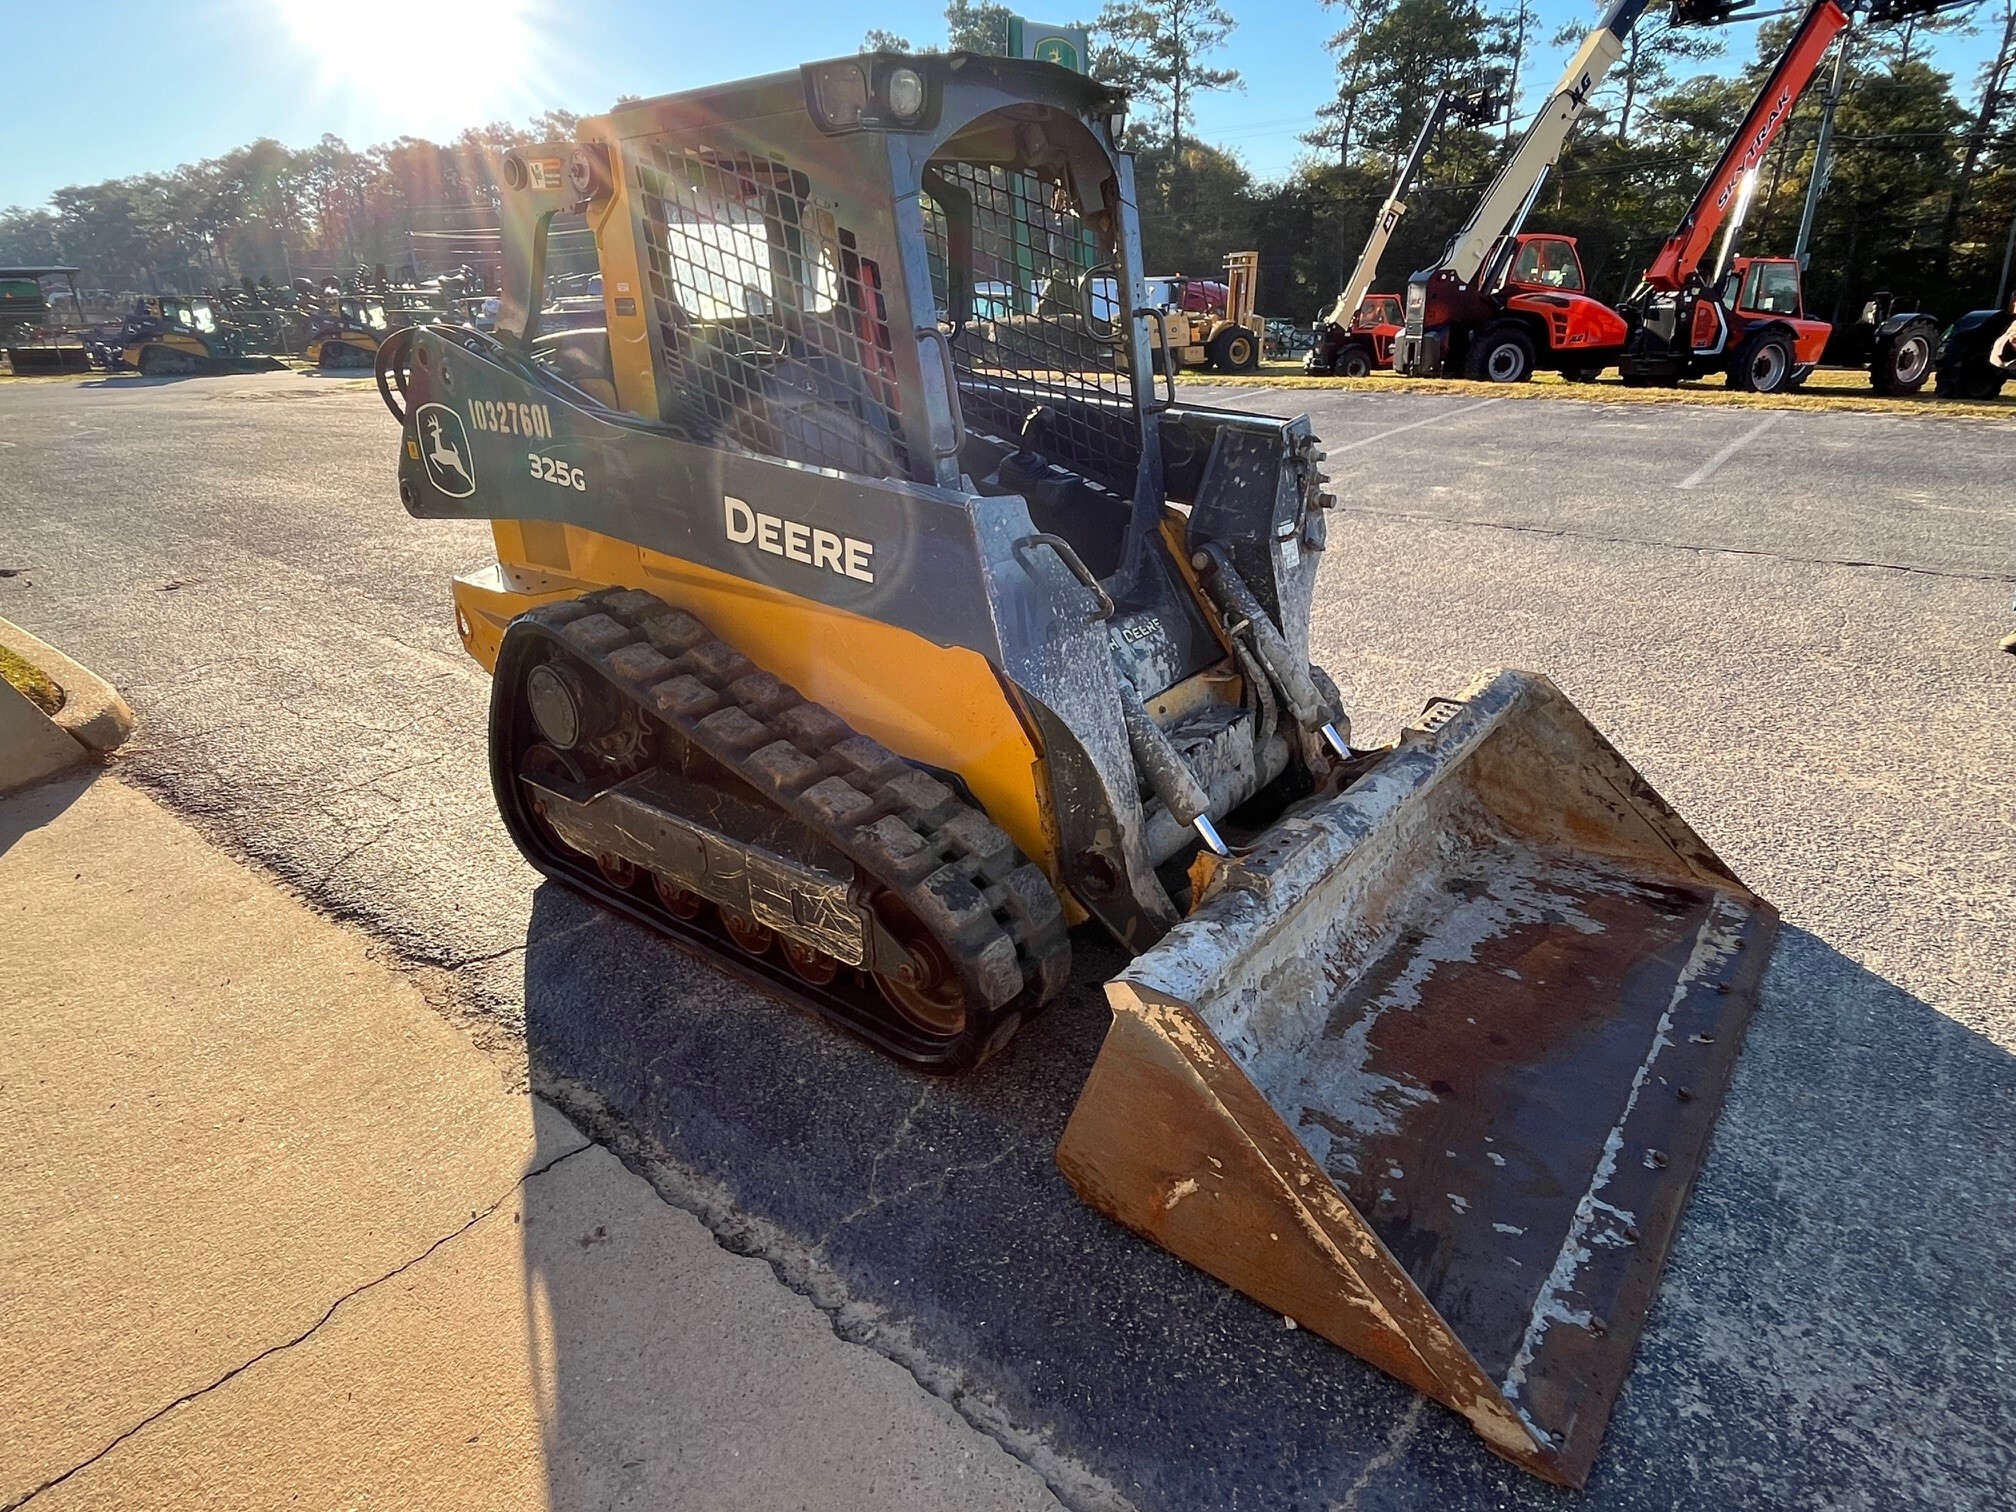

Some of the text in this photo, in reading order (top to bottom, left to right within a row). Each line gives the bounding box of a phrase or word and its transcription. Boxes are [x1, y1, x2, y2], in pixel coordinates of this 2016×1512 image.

[1717, 85, 1791, 212] SKYTRAK
[467, 398, 552, 439] 10327601
[528, 453, 587, 492] 325G
[724, 495, 875, 584] DEERE
[1121, 617, 1161, 643] DEERE
